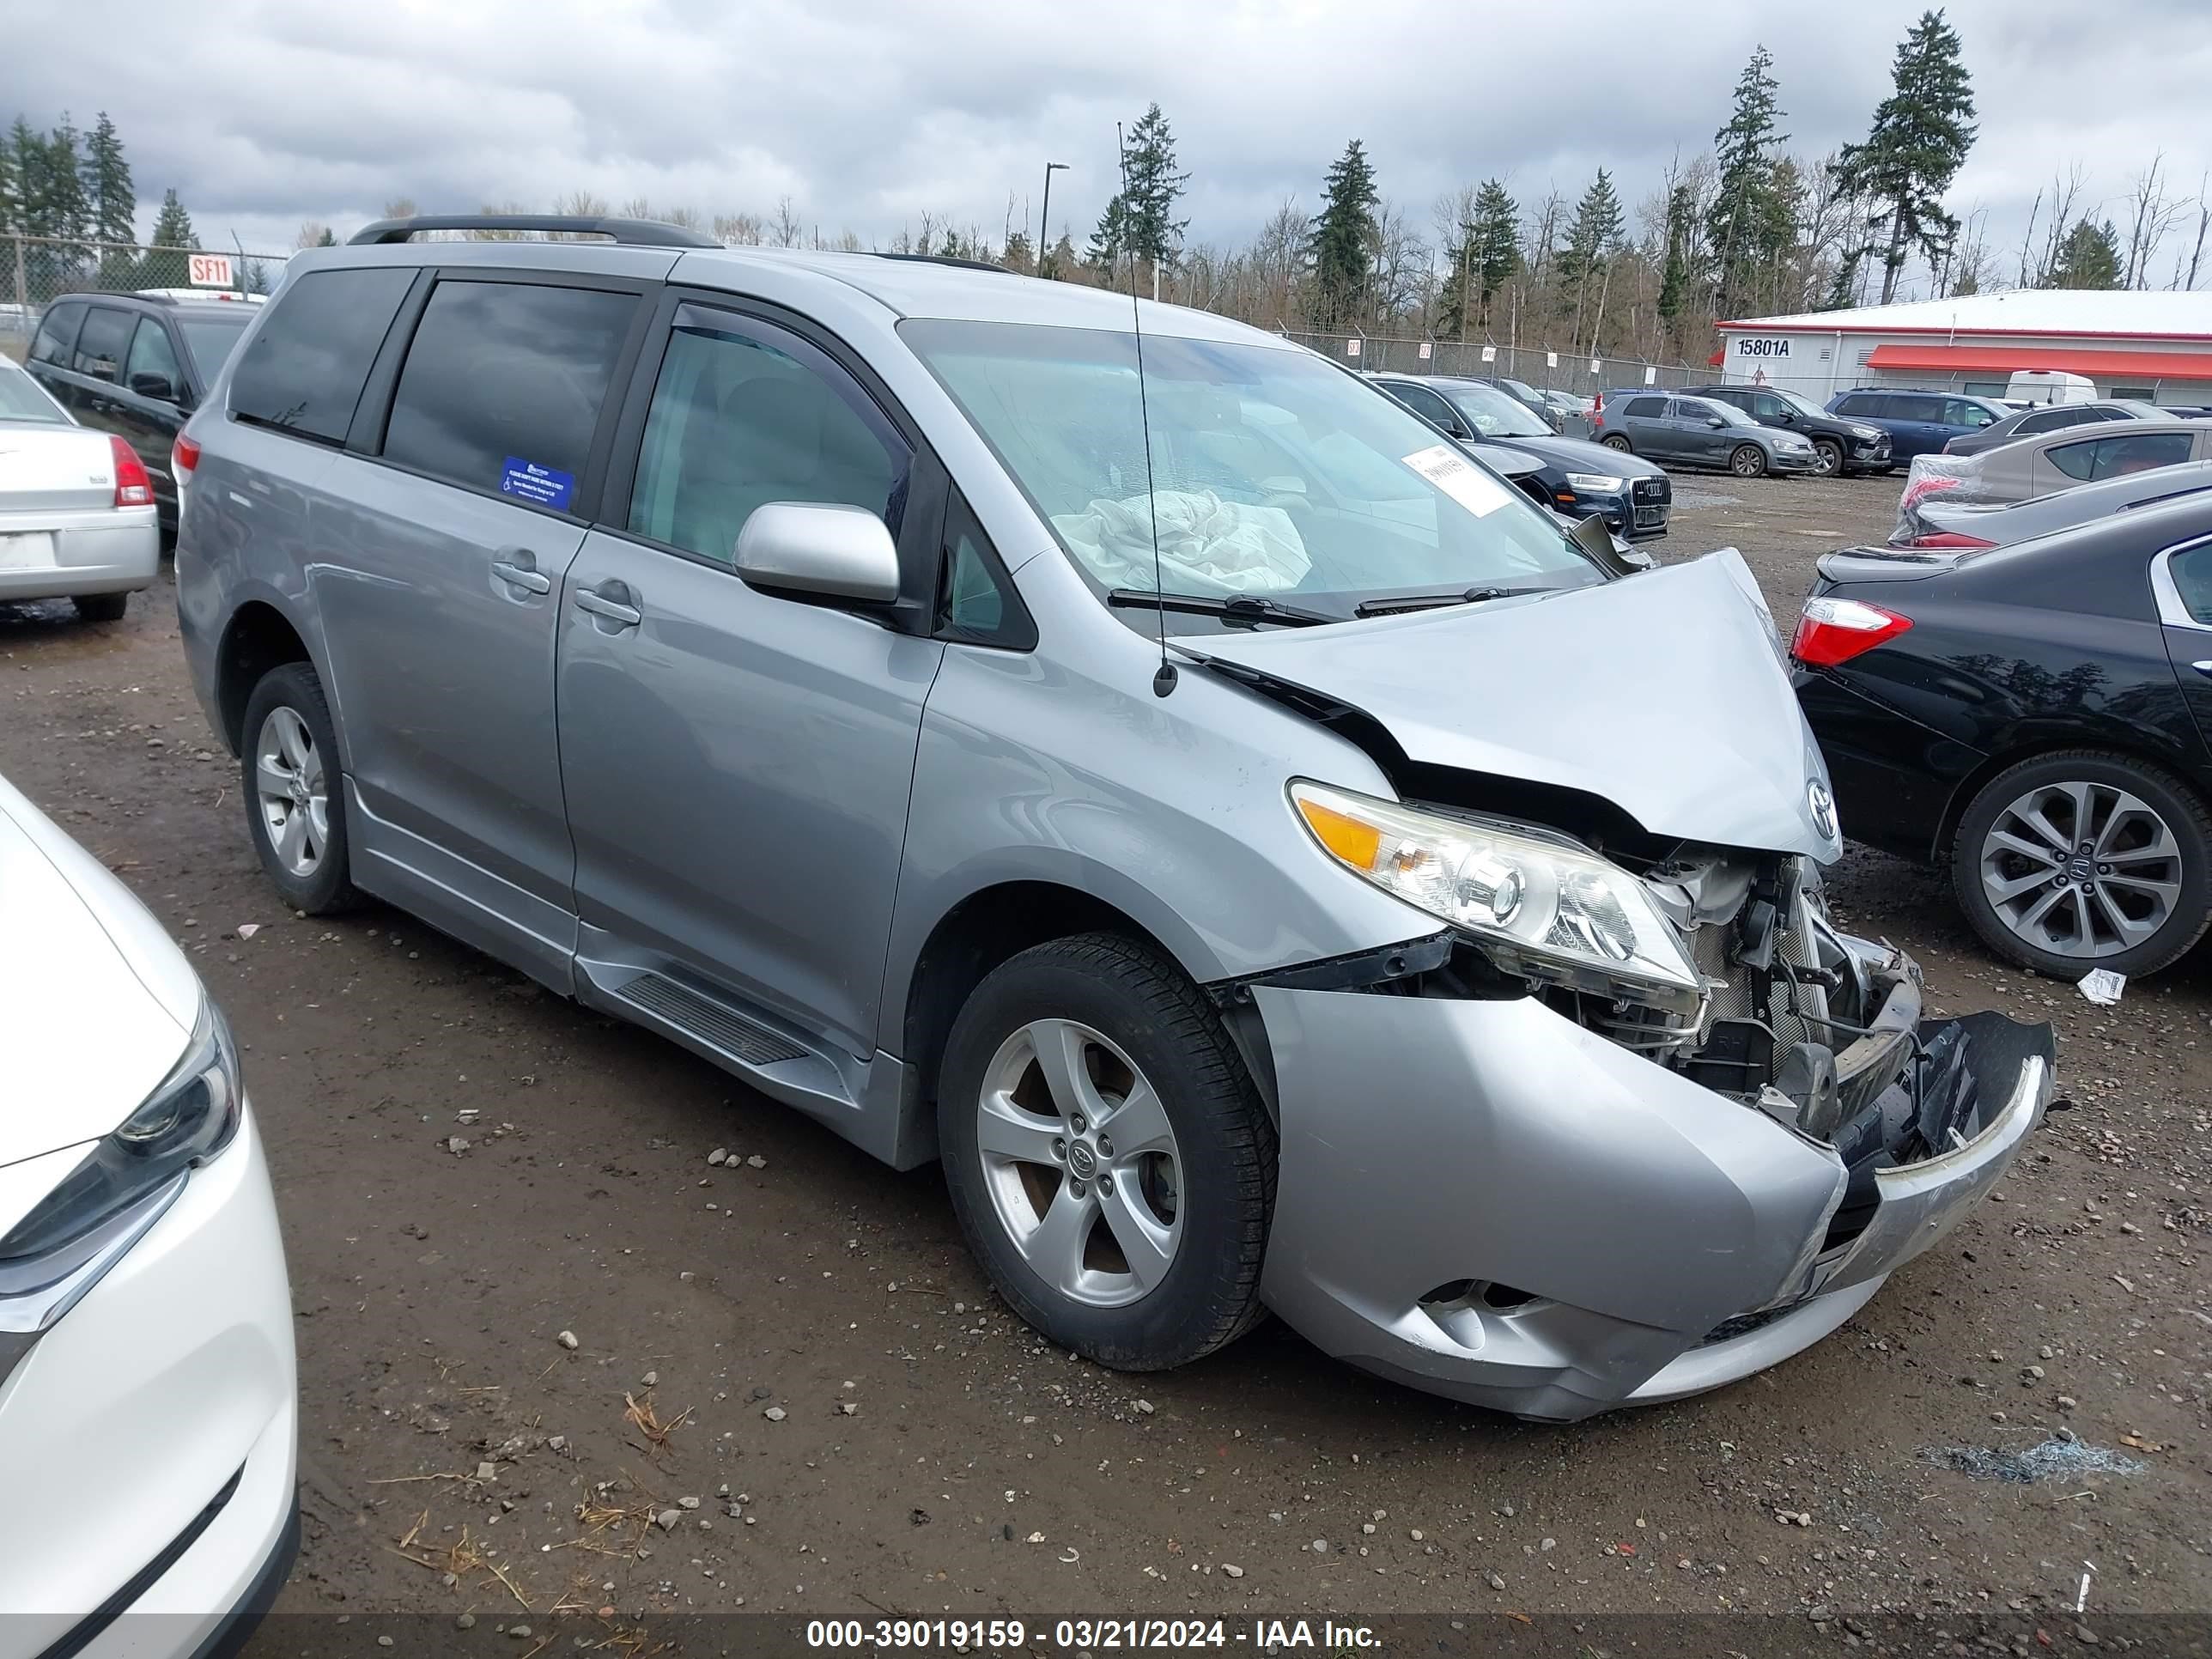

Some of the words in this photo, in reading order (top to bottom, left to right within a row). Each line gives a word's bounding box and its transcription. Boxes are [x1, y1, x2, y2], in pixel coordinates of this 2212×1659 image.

[193, 258, 228, 282] SF11
[1420, 345, 1431, 357] SF2
[1738, 339, 1789, 356] 15801A
